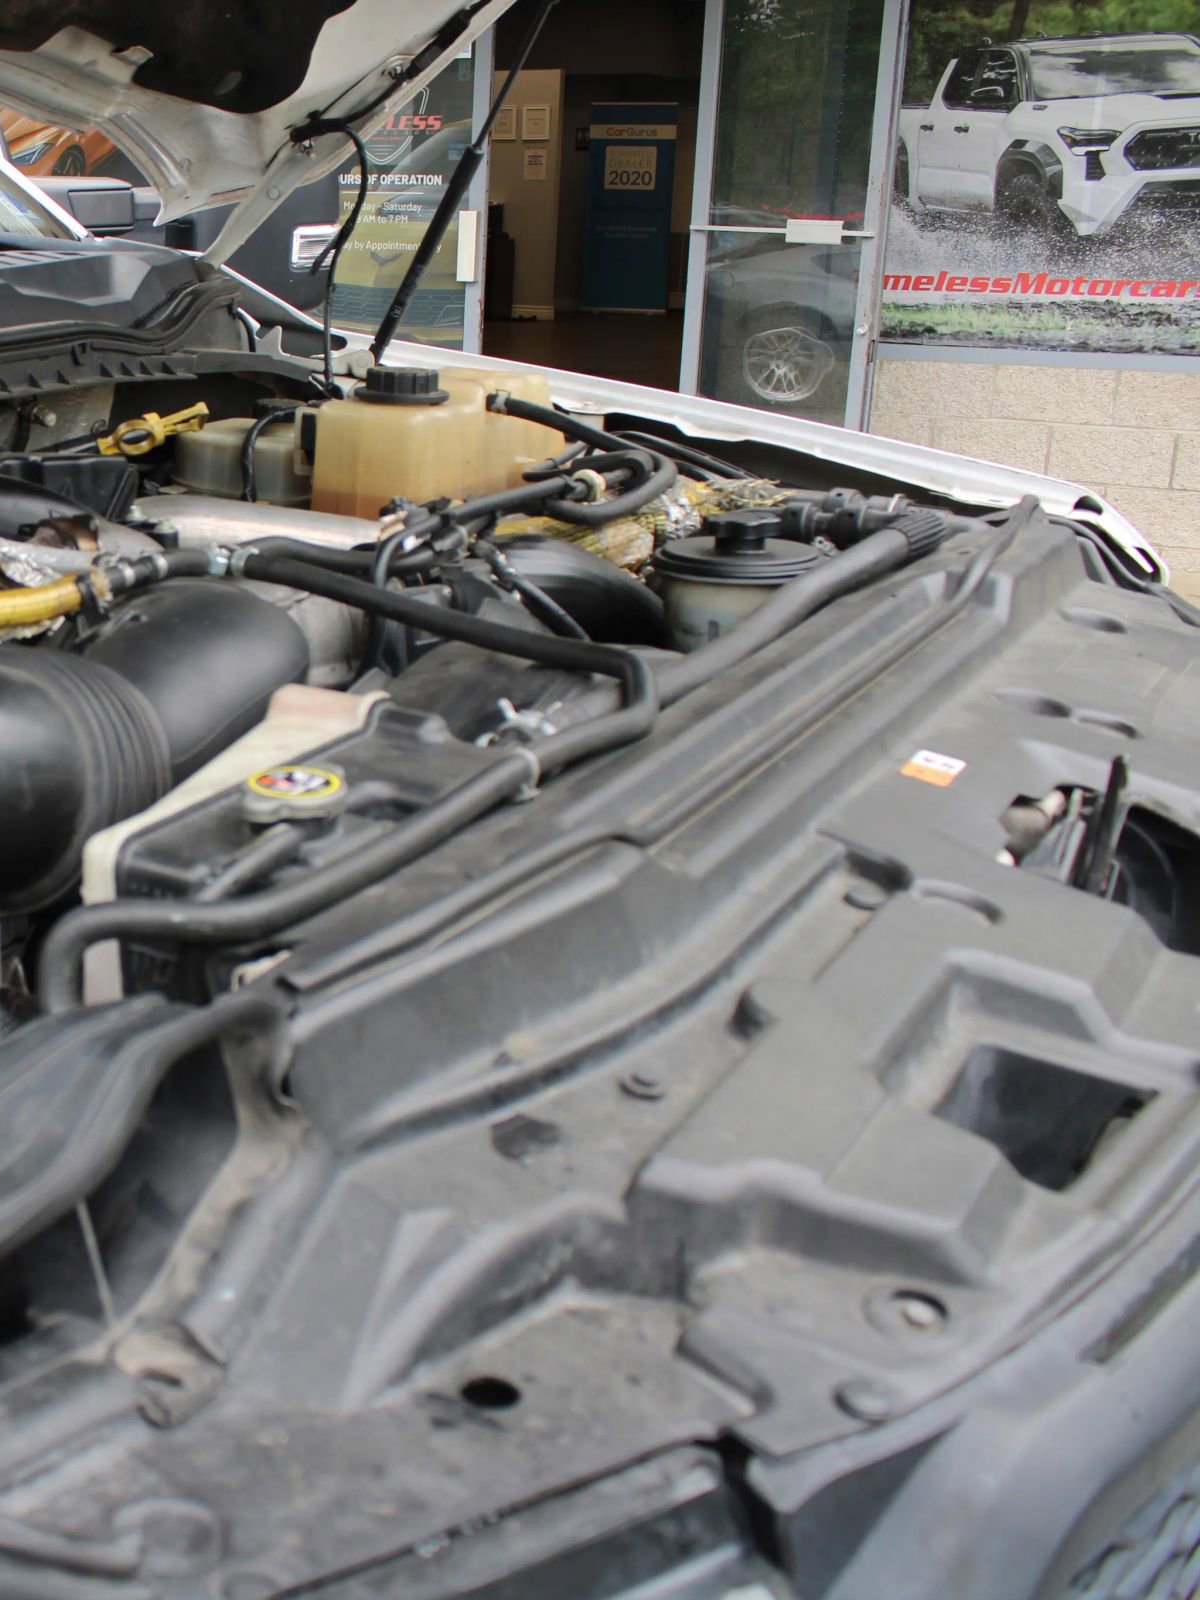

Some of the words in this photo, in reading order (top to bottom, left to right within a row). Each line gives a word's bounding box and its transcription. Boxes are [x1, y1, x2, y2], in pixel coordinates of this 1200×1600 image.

[379, 115, 443, 130] LESS
[607, 127, 658, 137] CarGurus
[338, 174, 362, 185] URS
[380, 174, 442, 186] OPERATION
[608, 170, 652, 185] 2020
[343, 201, 376, 213] Moday
[383, 201, 422, 214] Saturday
[363, 215, 376, 223] AM
[377, 216, 387, 224] to
[389, 216, 394, 224] 7
[395, 216, 408, 224] PM
[354, 240, 364, 251] by
[883, 271, 1200, 299] melessMotorcar
